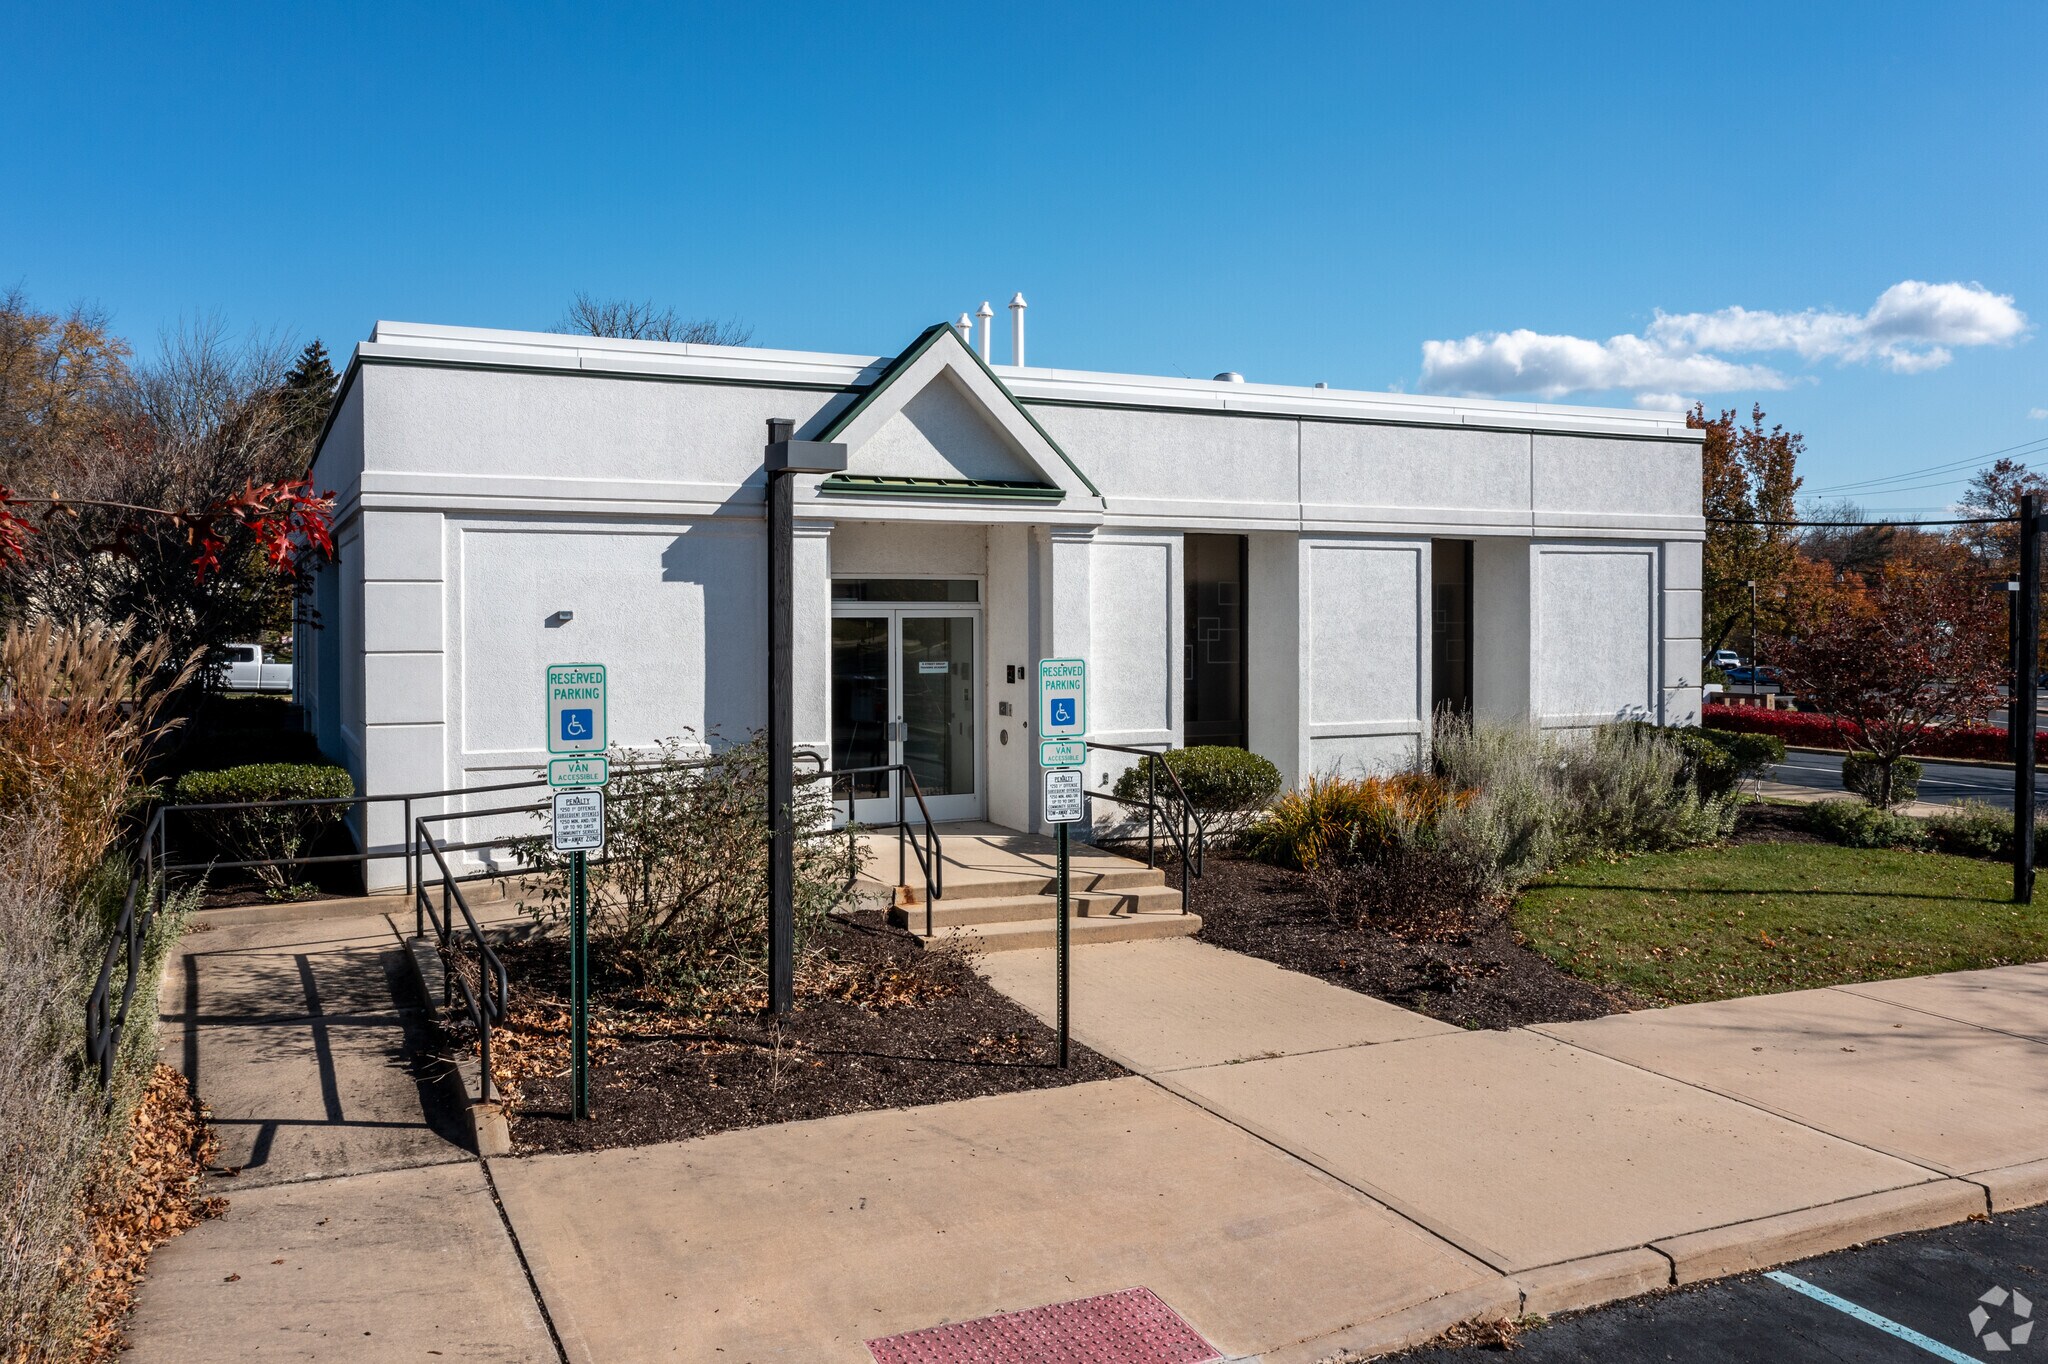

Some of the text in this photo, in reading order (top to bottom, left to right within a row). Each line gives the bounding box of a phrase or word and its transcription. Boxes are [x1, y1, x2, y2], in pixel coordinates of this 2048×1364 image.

[1043, 666, 1082, 676] RESERVED
[551, 672, 603, 684] RESERVED
[1046, 680, 1080, 690] PARKING
[554, 688, 600, 700] PARKING
[568, 764, 589, 772] VAN
